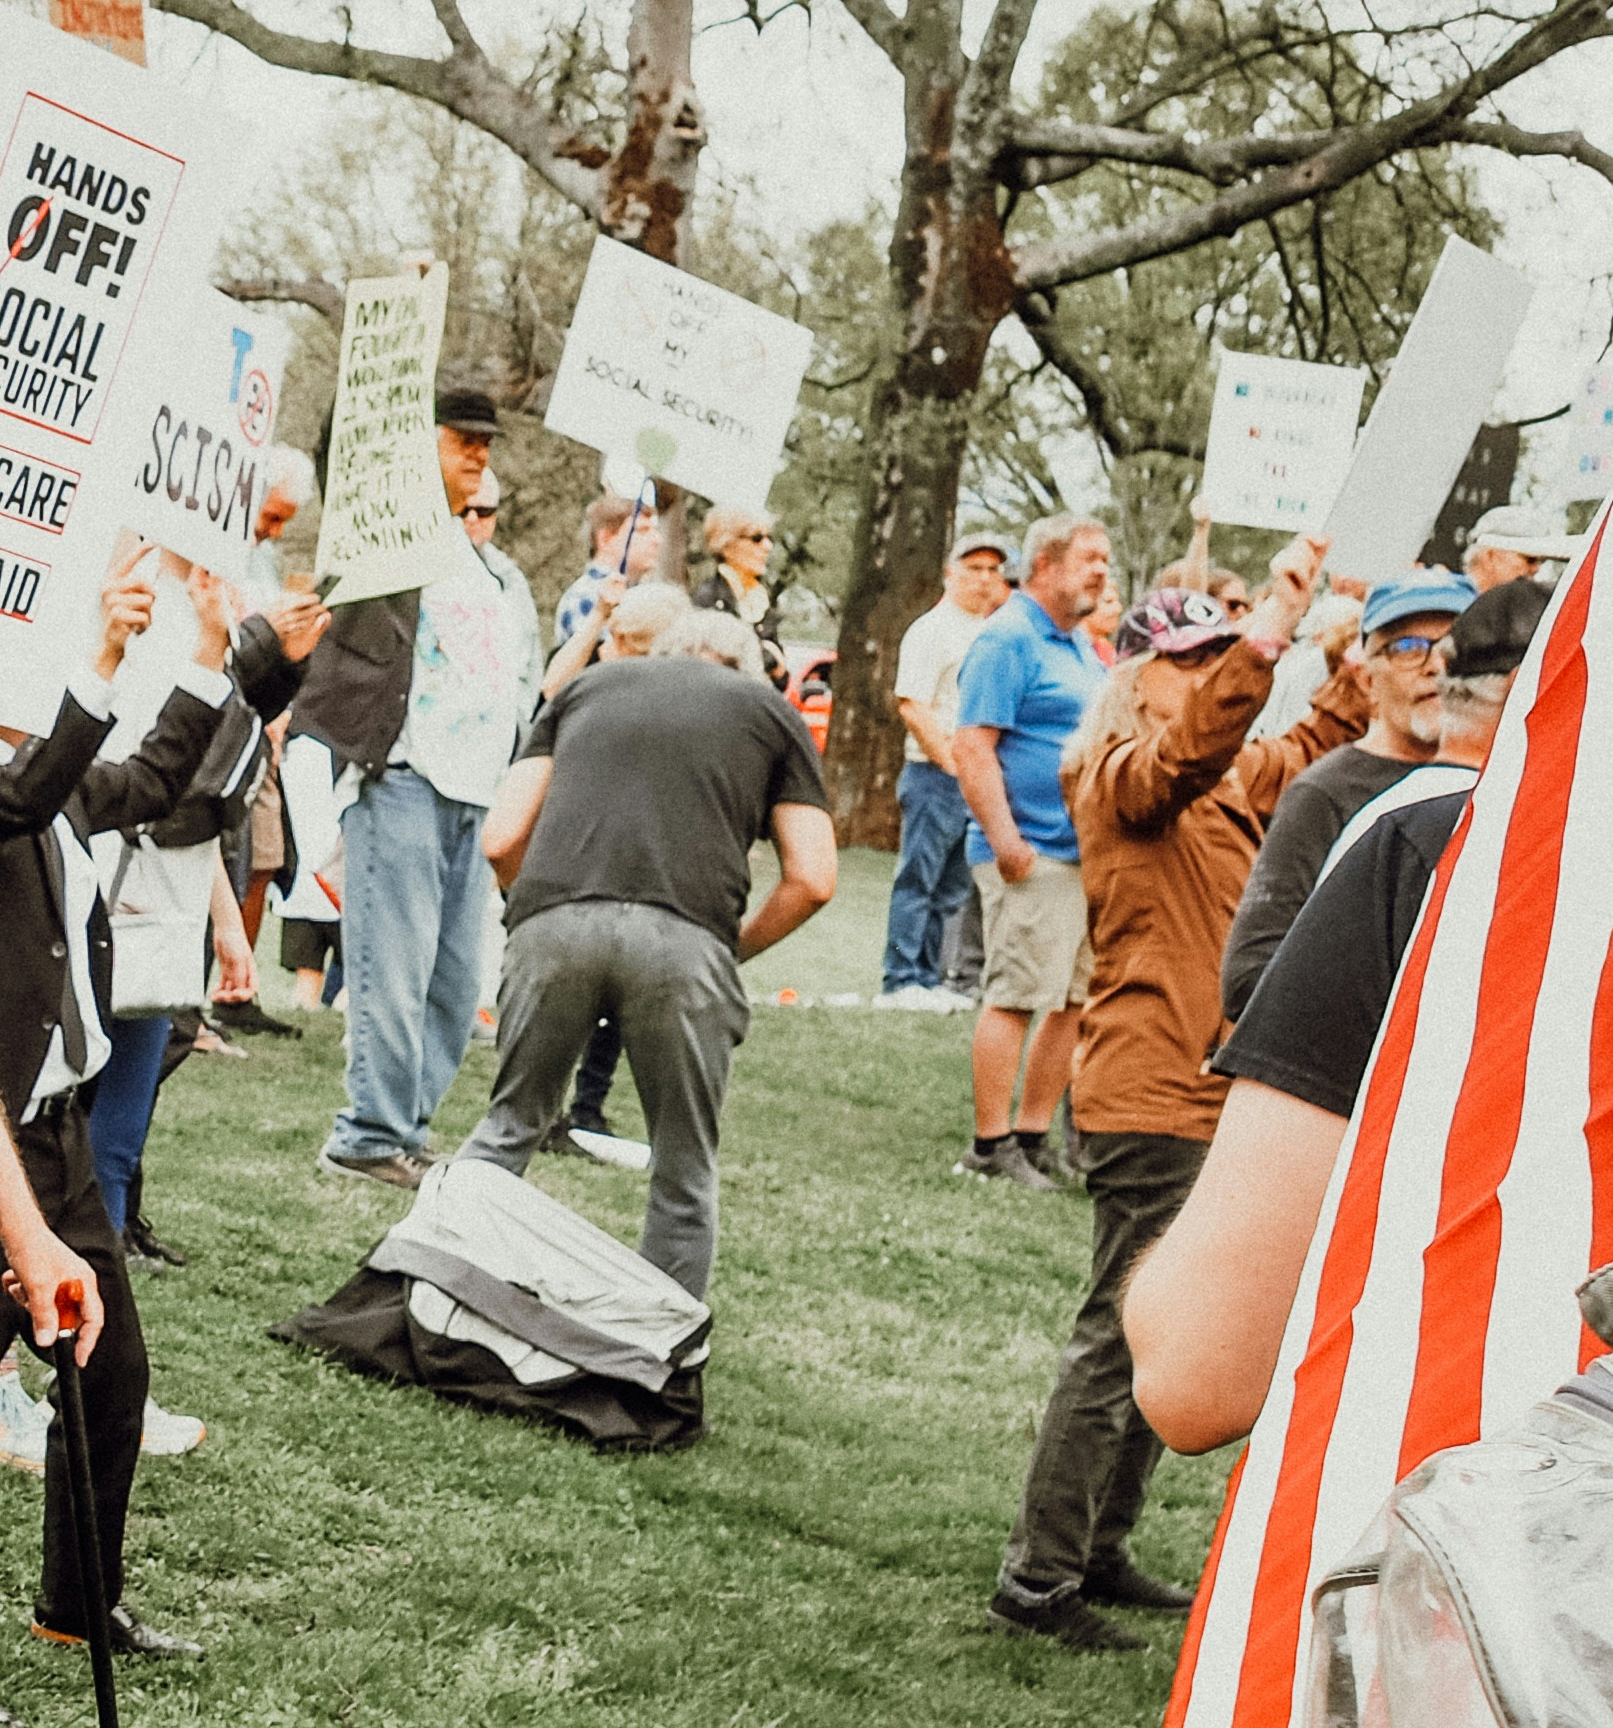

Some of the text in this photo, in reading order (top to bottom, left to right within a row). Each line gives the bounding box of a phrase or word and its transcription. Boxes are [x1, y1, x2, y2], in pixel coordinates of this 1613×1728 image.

[26, 142, 151, 225] HANDS
[7, 194, 137, 299] OFF!
[584, 355, 651, 400] SOCIAL
[135, 404, 256, 541] SCISM
